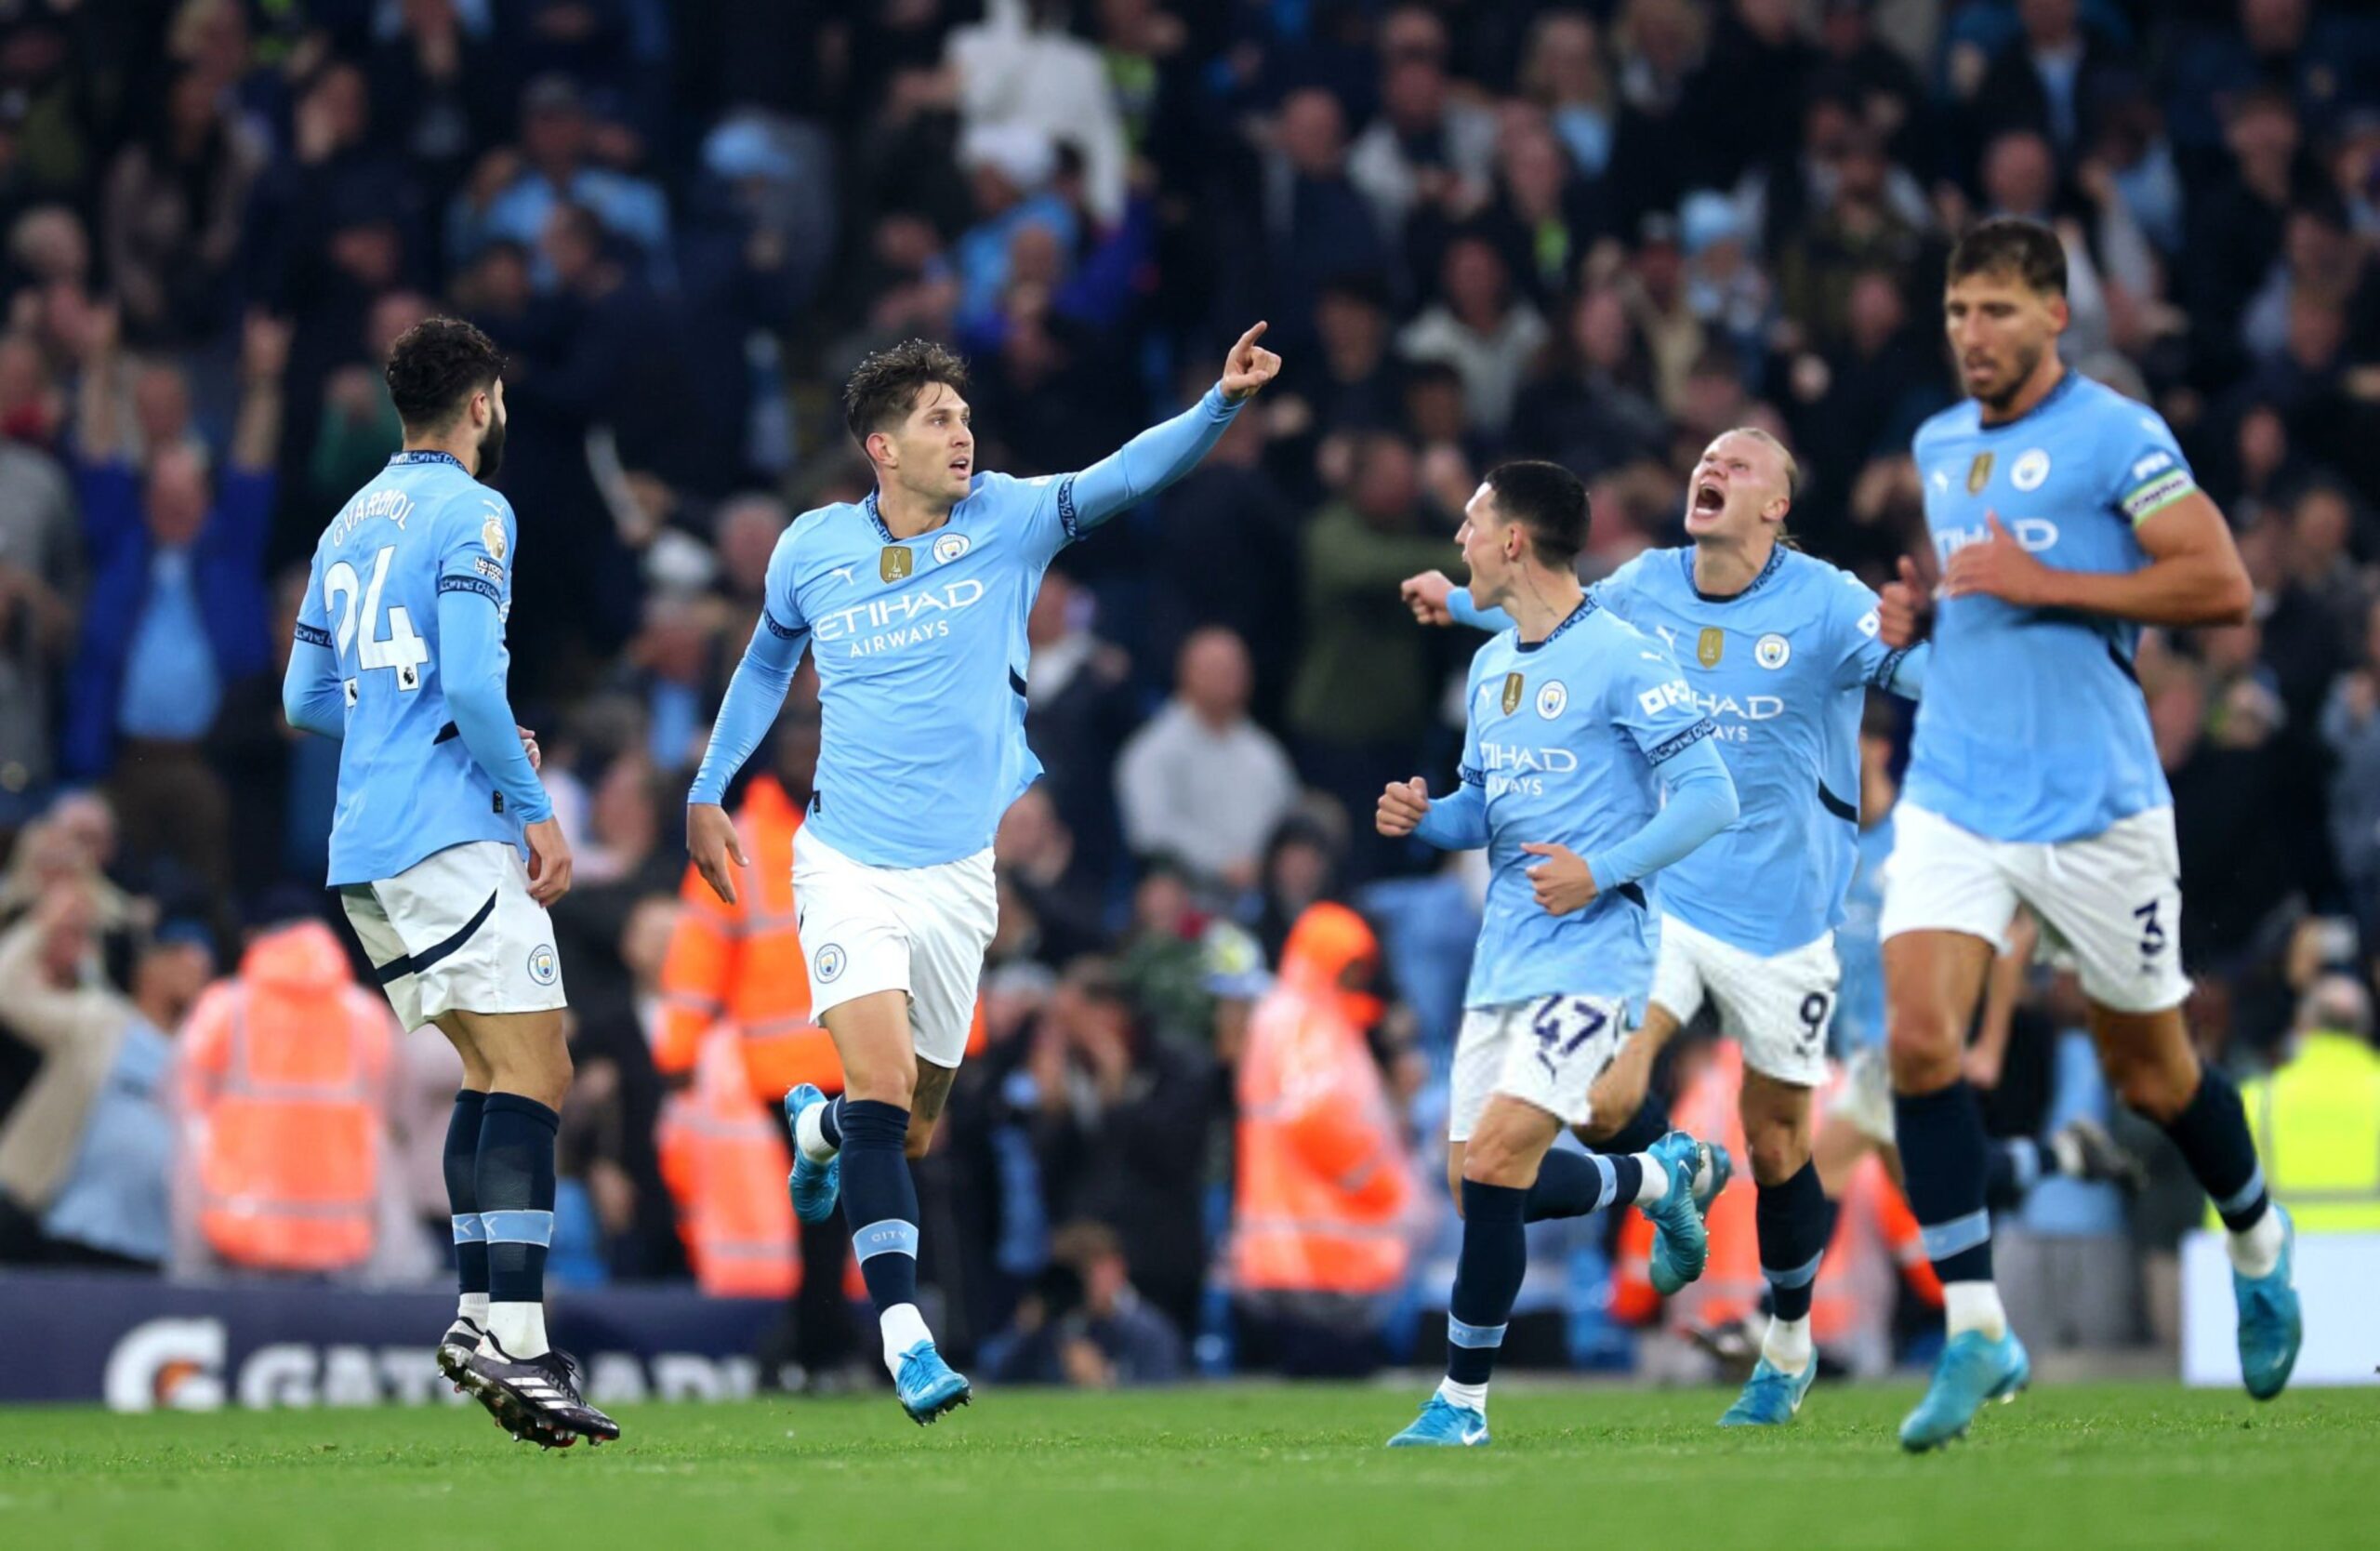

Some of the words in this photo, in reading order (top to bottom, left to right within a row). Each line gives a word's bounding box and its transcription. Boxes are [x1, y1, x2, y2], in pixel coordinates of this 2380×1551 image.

[333, 488, 416, 548] GVARDIOL
[323, 545, 430, 708] 24
[816, 577, 985, 642] ETIHAD
[850, 619, 950, 659] AIRWAYS
[1479, 741, 1578, 772] TIHAD
[2134, 899, 2165, 954] 3
[1532, 993, 1607, 1056] 47
[1800, 991, 1829, 1041] 9
[871, 1230, 907, 1243] CITY
